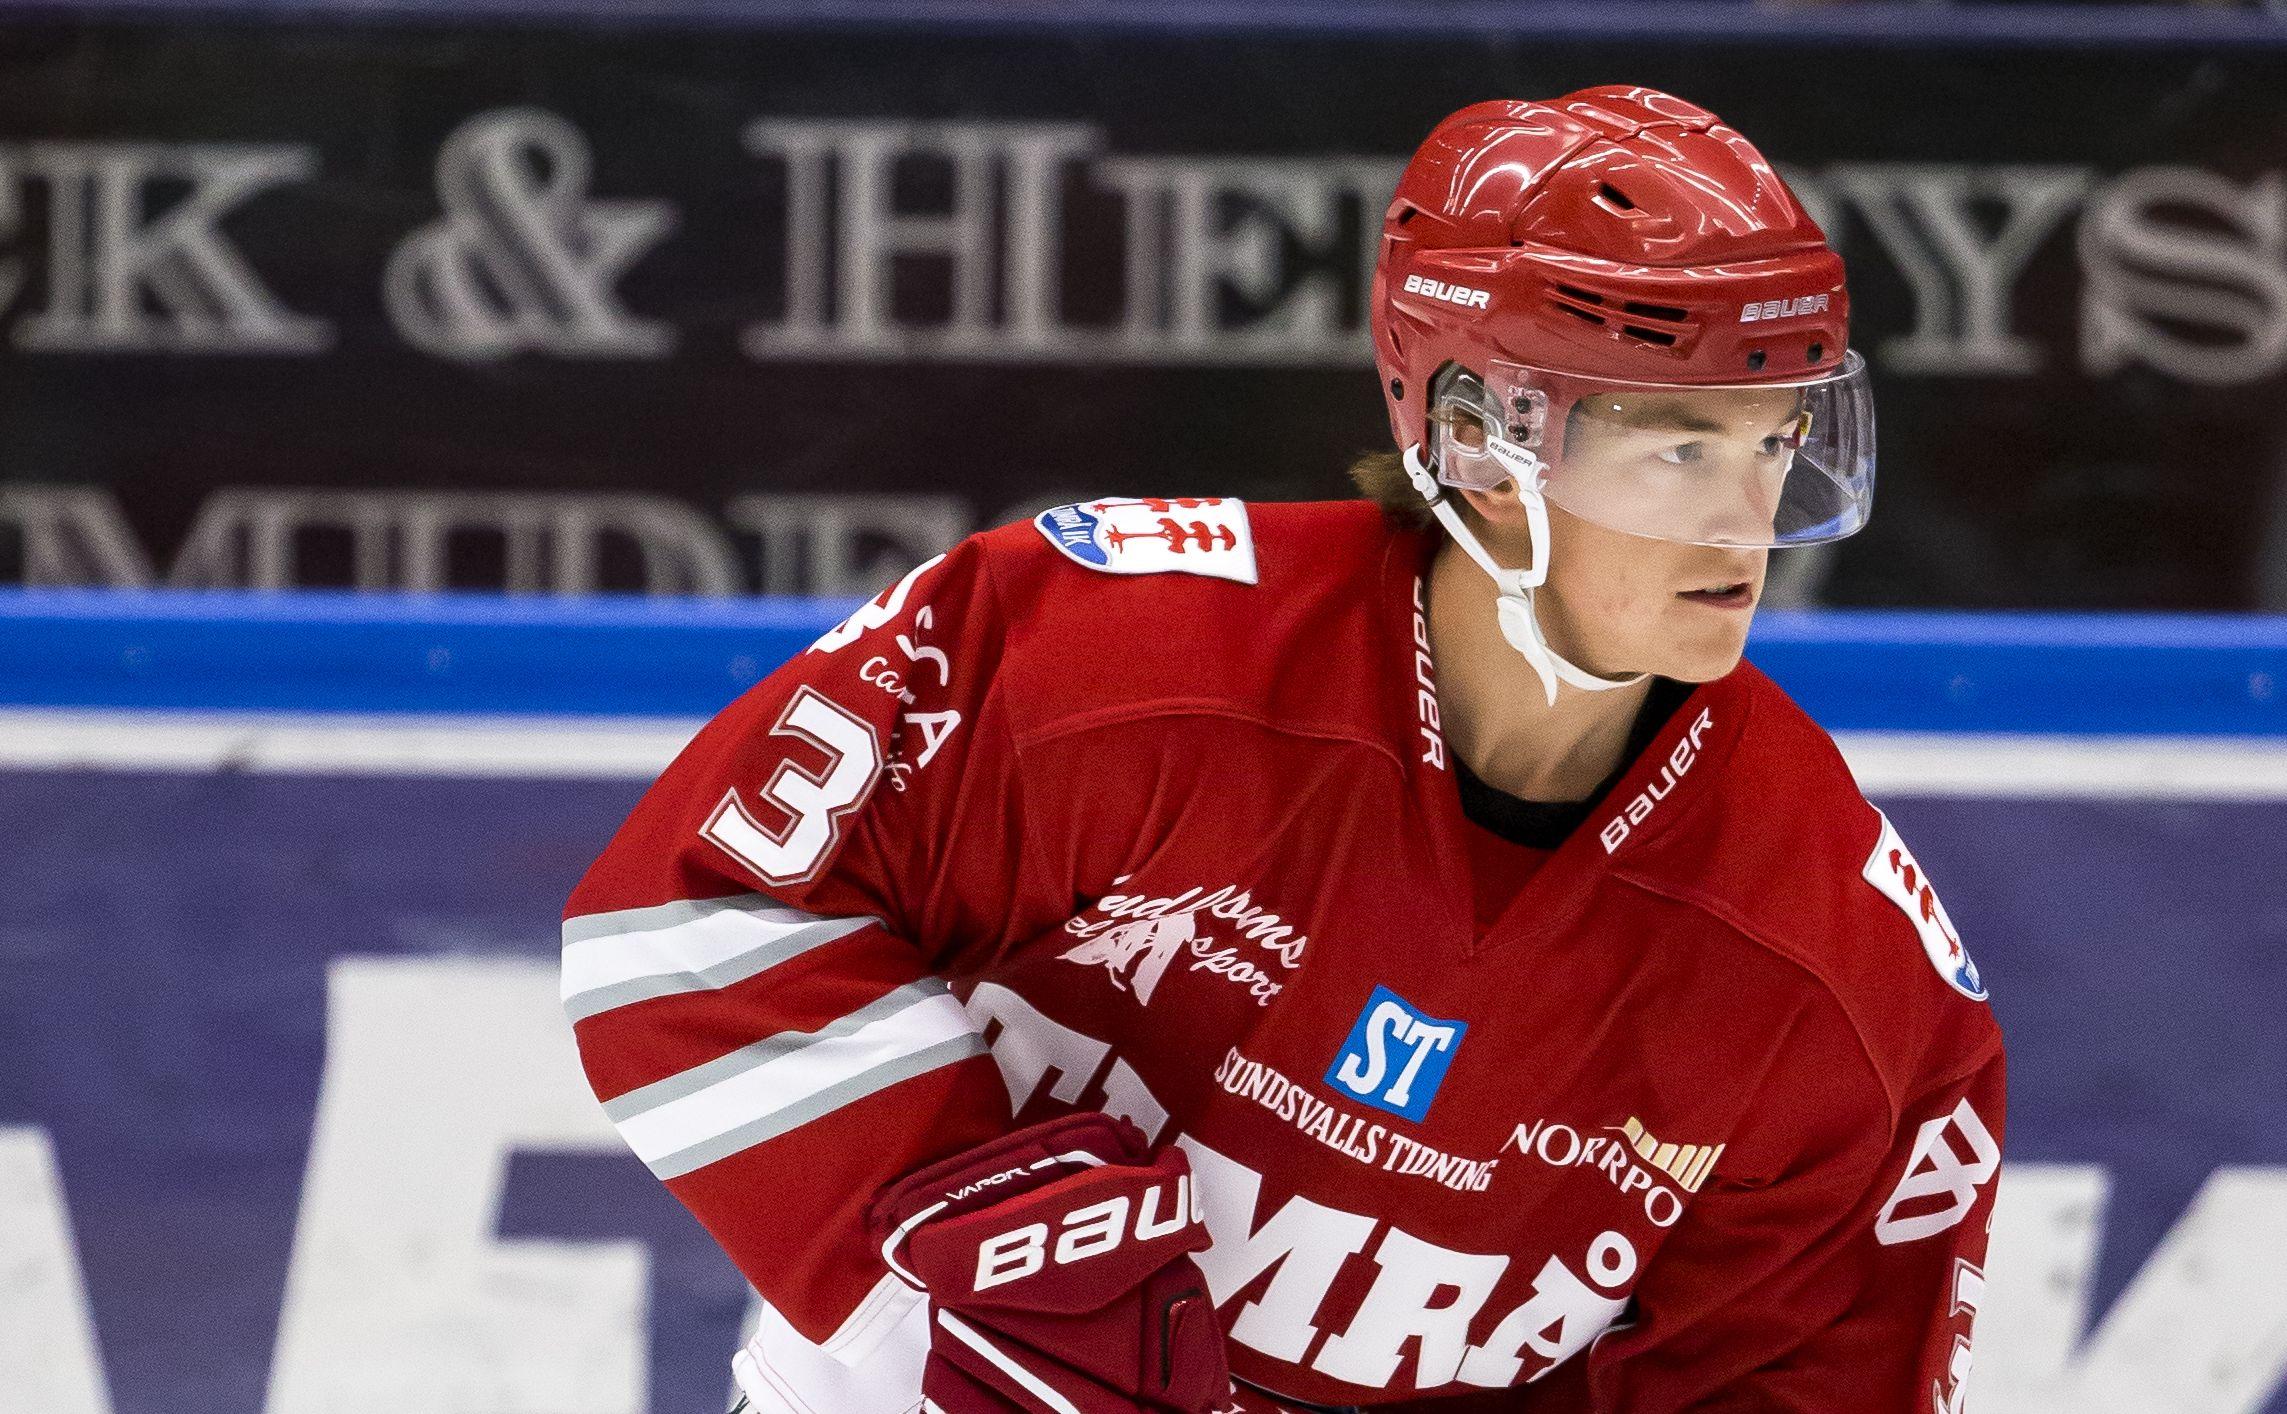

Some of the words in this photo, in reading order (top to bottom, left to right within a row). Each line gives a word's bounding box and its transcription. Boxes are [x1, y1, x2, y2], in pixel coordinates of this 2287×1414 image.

[381, 106, 682, 362] &
[1403, 274, 1491, 310] BAUER
[1740, 293, 1829, 323] BAUER
[1489, 441, 1533, 467] BAUER
[698, 684, 885, 887] 3
[1600, 707, 1713, 855] BAUER
[1336, 1001, 1445, 1107] ST
[1214, 1046, 1386, 1164] SUNDSVALLS
[1382, 1132, 1499, 1192] TIDNING
[945, 1167, 1031, 1201] VAPOR
